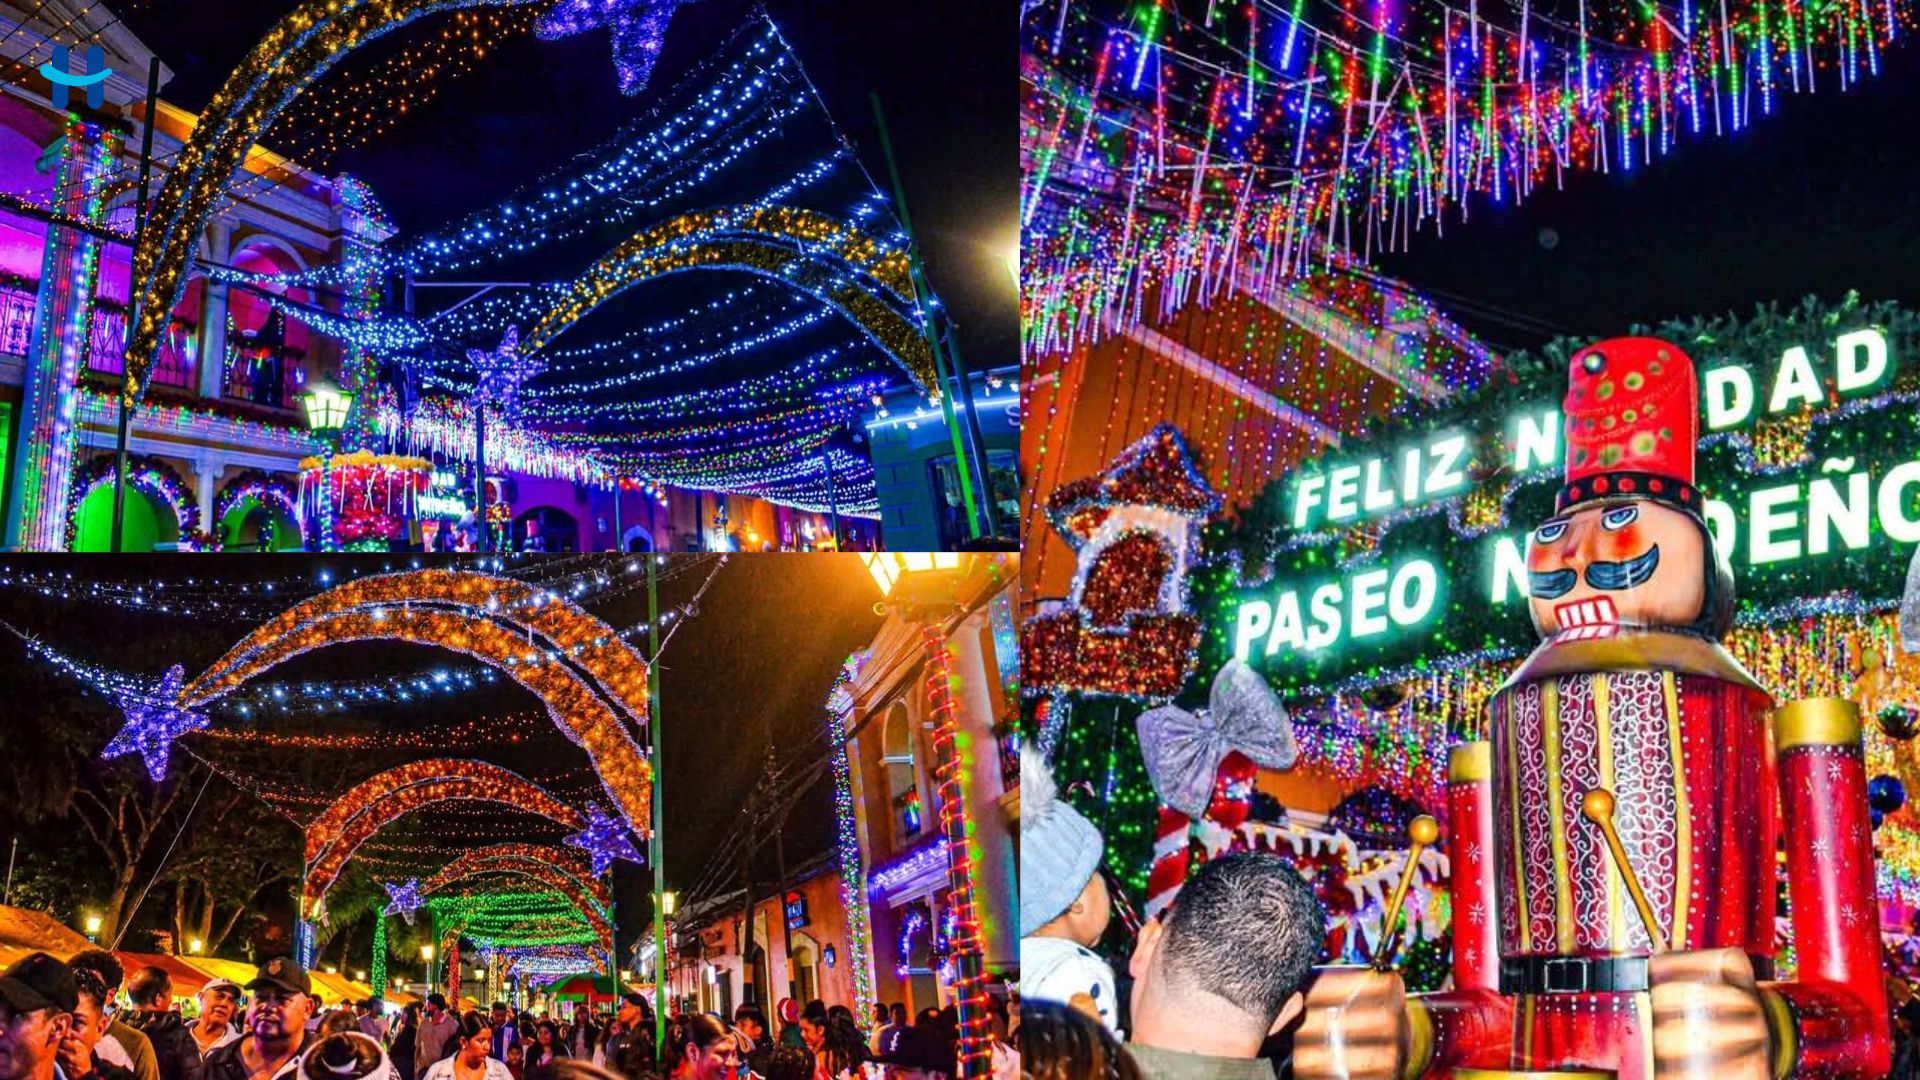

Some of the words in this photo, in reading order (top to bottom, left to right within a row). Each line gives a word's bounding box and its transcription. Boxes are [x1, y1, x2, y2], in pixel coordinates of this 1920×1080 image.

[1294, 436, 1466, 528] FELIZ
[1515, 329, 1888, 471] NDAD
[1234, 559, 1437, 662] PASEO
